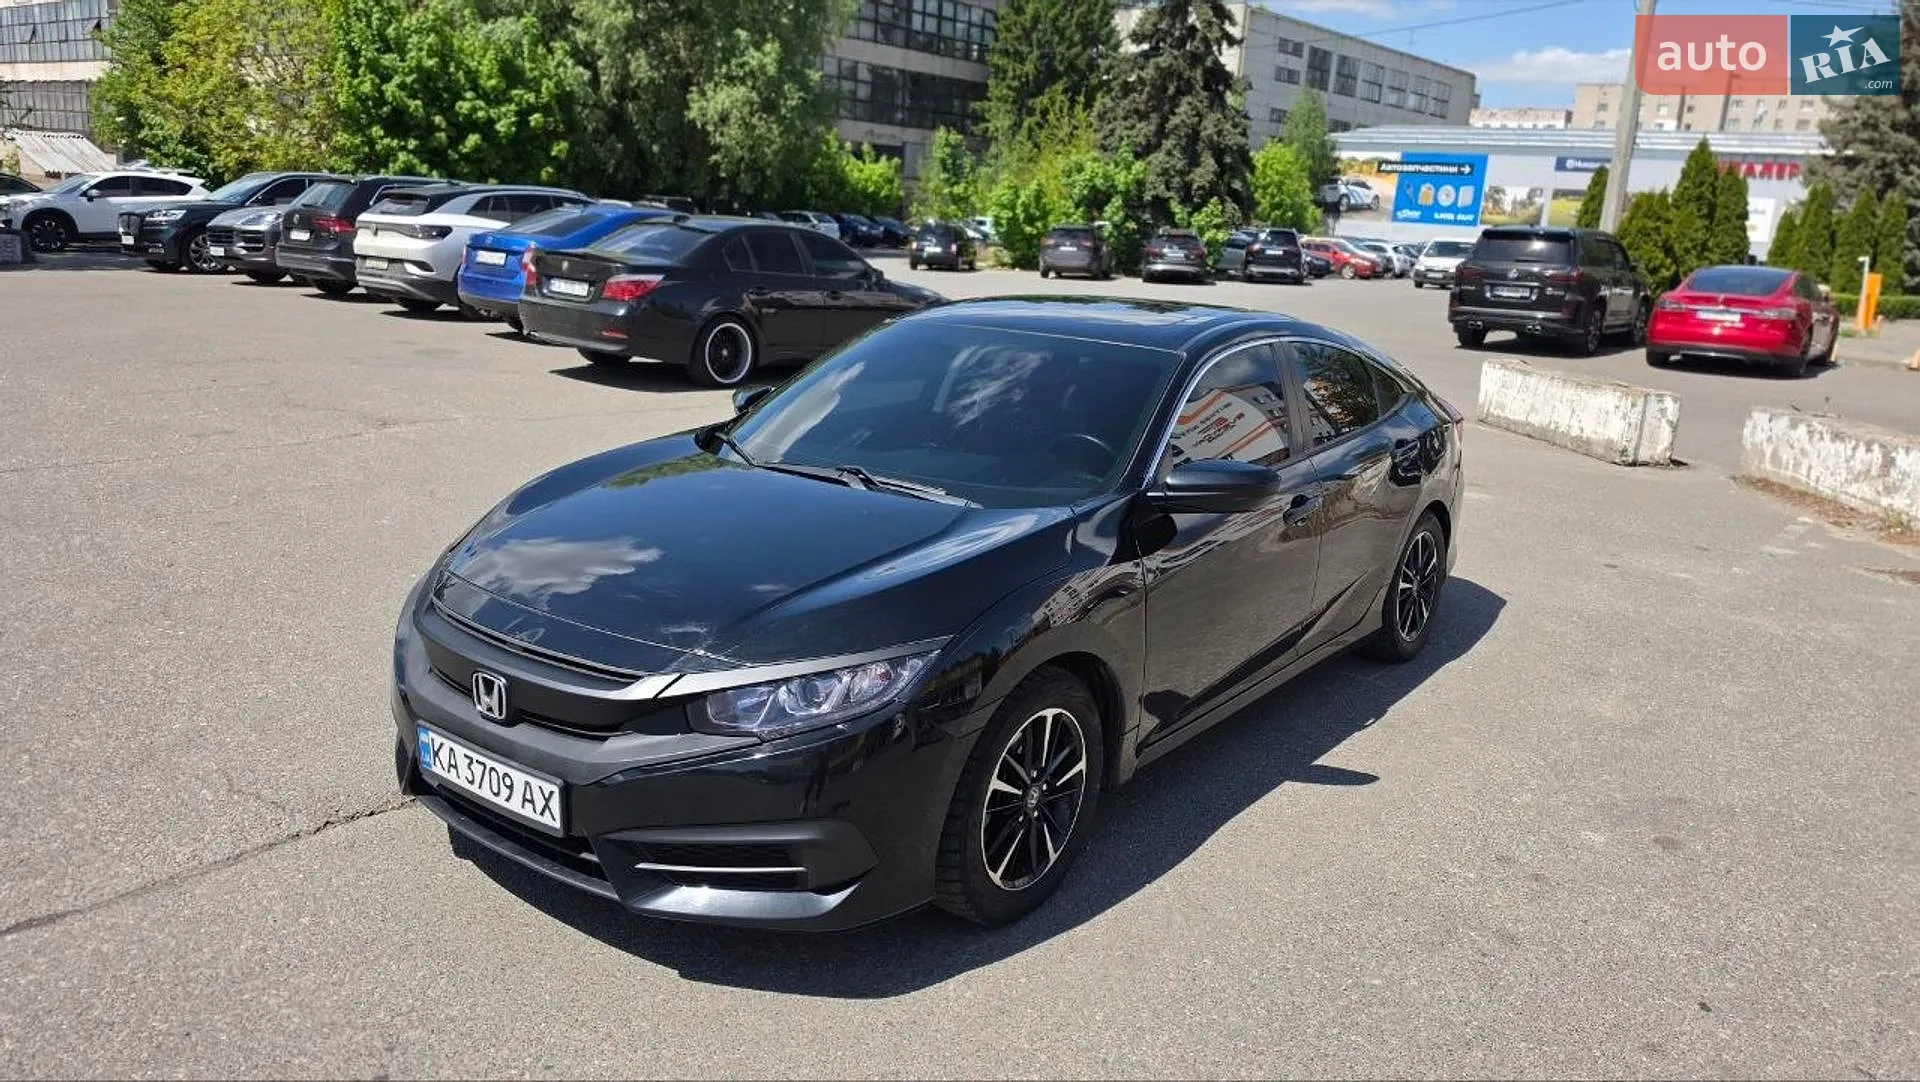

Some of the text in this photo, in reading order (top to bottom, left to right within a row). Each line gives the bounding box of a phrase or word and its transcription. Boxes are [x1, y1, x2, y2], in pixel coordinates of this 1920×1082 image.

[1380, 162, 1458, 173] Автозапчастини
[431, 738, 460, 779] KA
[463, 755, 515, 802] 3709
[521, 780, 557, 822] AX
